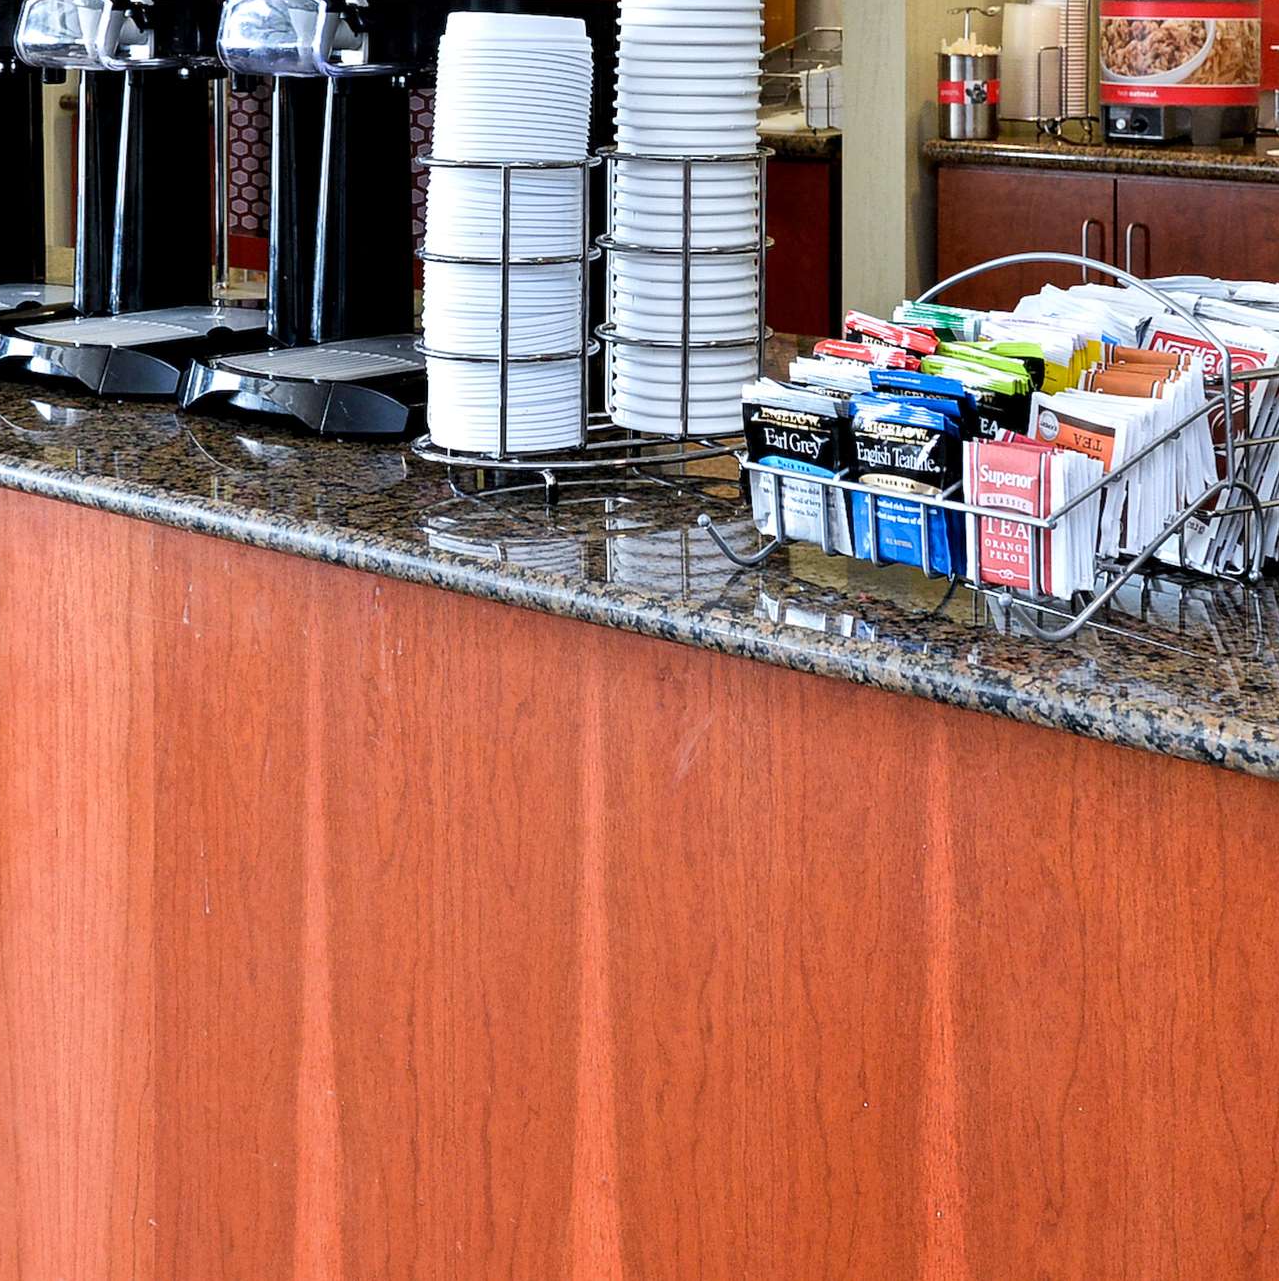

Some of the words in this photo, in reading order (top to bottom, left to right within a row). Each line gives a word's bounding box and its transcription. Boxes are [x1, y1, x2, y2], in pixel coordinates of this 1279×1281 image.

[979, 417, 999, 436] EA
[763, 427, 788, 450] Earl
[789, 432, 823, 459] Grey
[1073, 433, 1103, 453] TEA
[856, 441, 891, 468] English
[986, 495, 1027, 510] CLASSIC
[984, 516, 1029, 539] TEA
[984, 538, 1029, 554] ORANGE
[989, 549, 1025, 564] PEKOE
